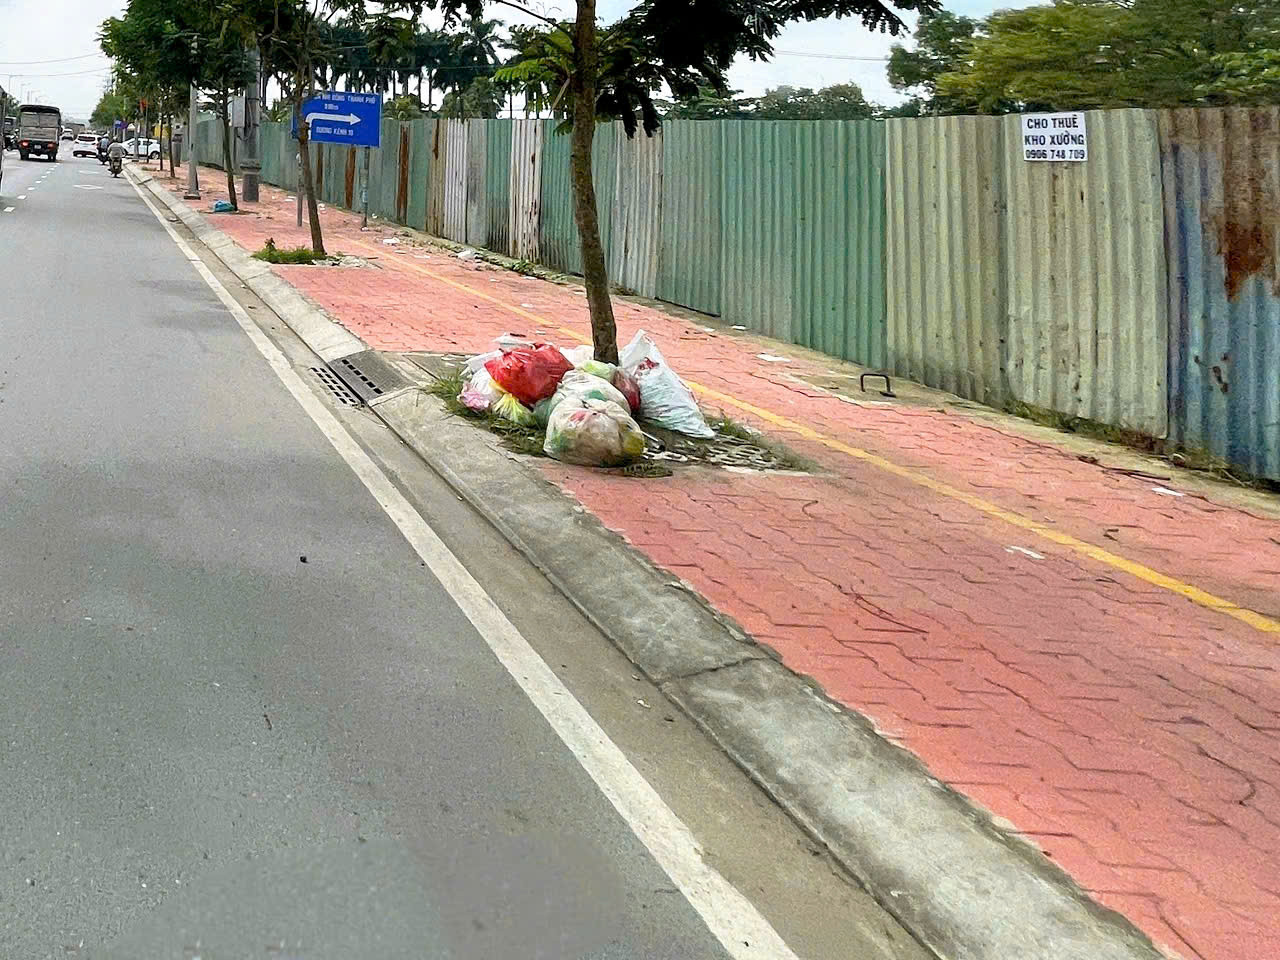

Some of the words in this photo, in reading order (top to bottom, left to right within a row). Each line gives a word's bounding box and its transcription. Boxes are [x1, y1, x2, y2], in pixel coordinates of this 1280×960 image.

[1027, 118, 1048, 128] CHO
[1051, 114, 1079, 128] THUÊ
[1024, 134, 1046, 145] KHO
[1025, 149, 1048, 159] 0906
[1050, 149, 1066, 159] 748
